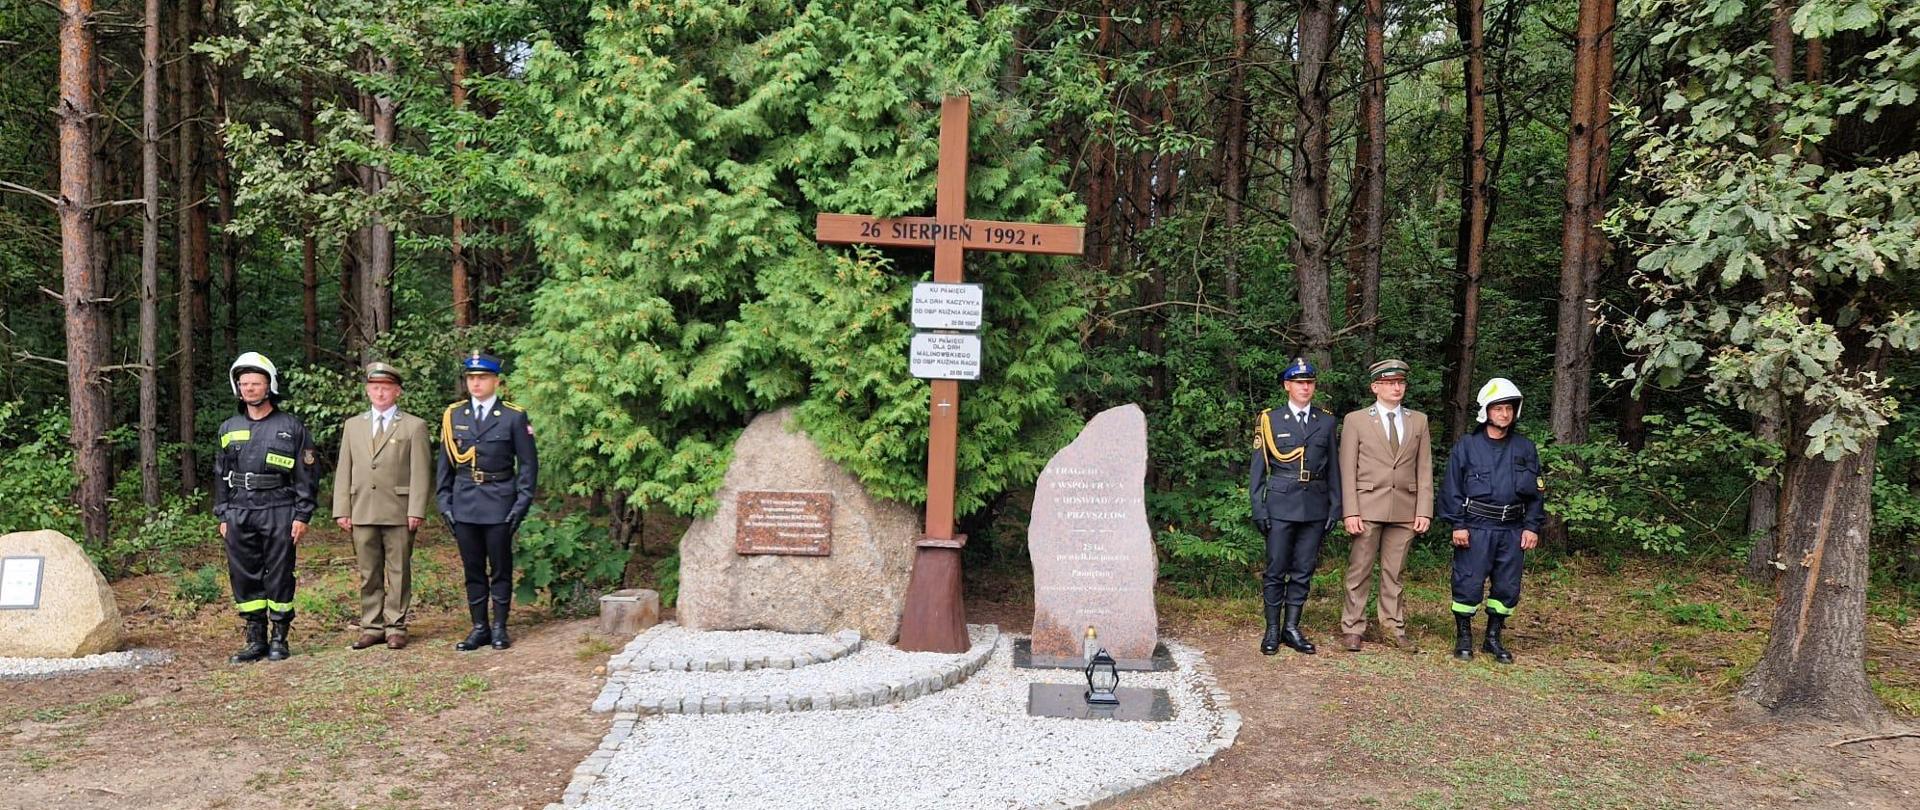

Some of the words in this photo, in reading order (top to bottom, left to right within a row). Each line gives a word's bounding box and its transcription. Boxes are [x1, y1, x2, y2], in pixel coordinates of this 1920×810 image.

[860, 221, 881, 238] 26
[891, 222, 972, 242] SIERPIEŃ
[984, 227, 1025, 245] 1992
[1031, 232, 1042, 246] r.
